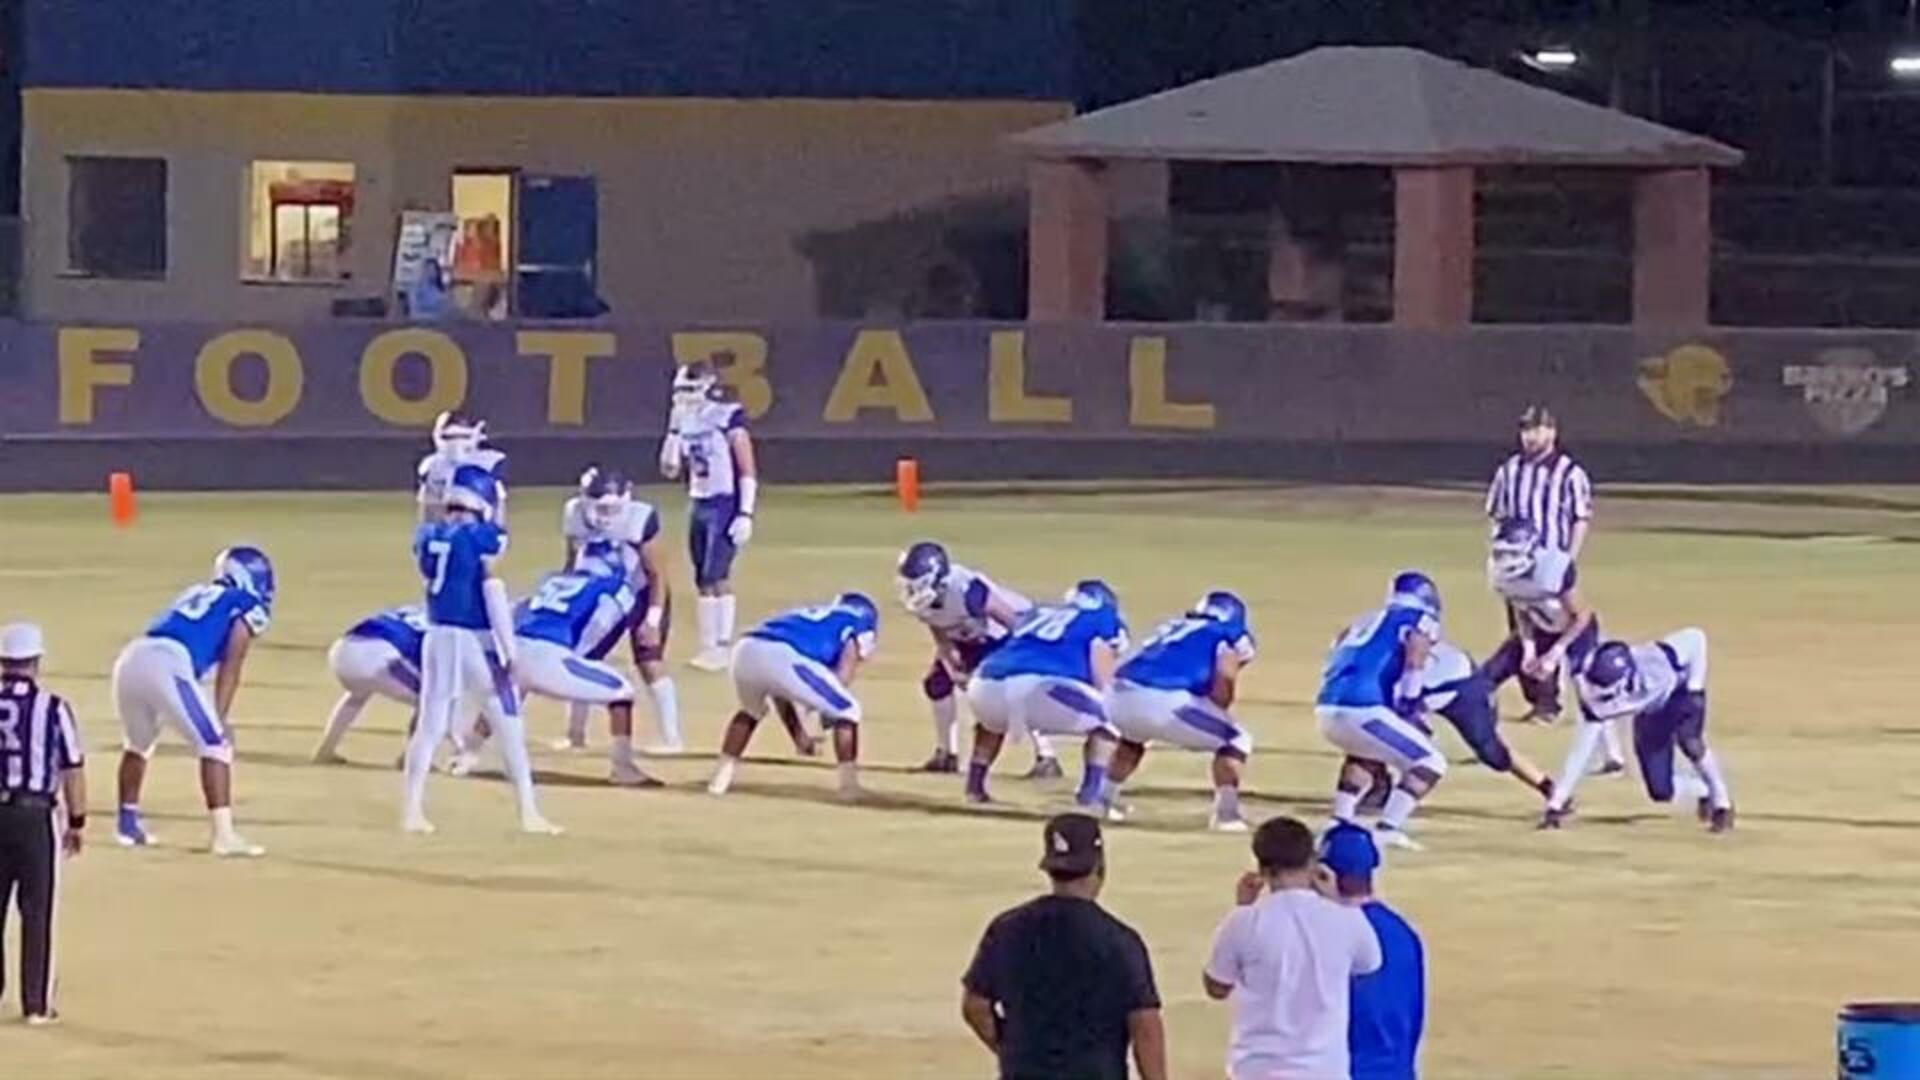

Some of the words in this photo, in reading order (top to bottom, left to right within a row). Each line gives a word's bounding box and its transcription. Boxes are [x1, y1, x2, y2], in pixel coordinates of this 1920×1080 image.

[57, 327, 1216, 428] FOOTBALL
[427, 540, 452, 595] 7
[1013, 606, 1081, 642] 78
